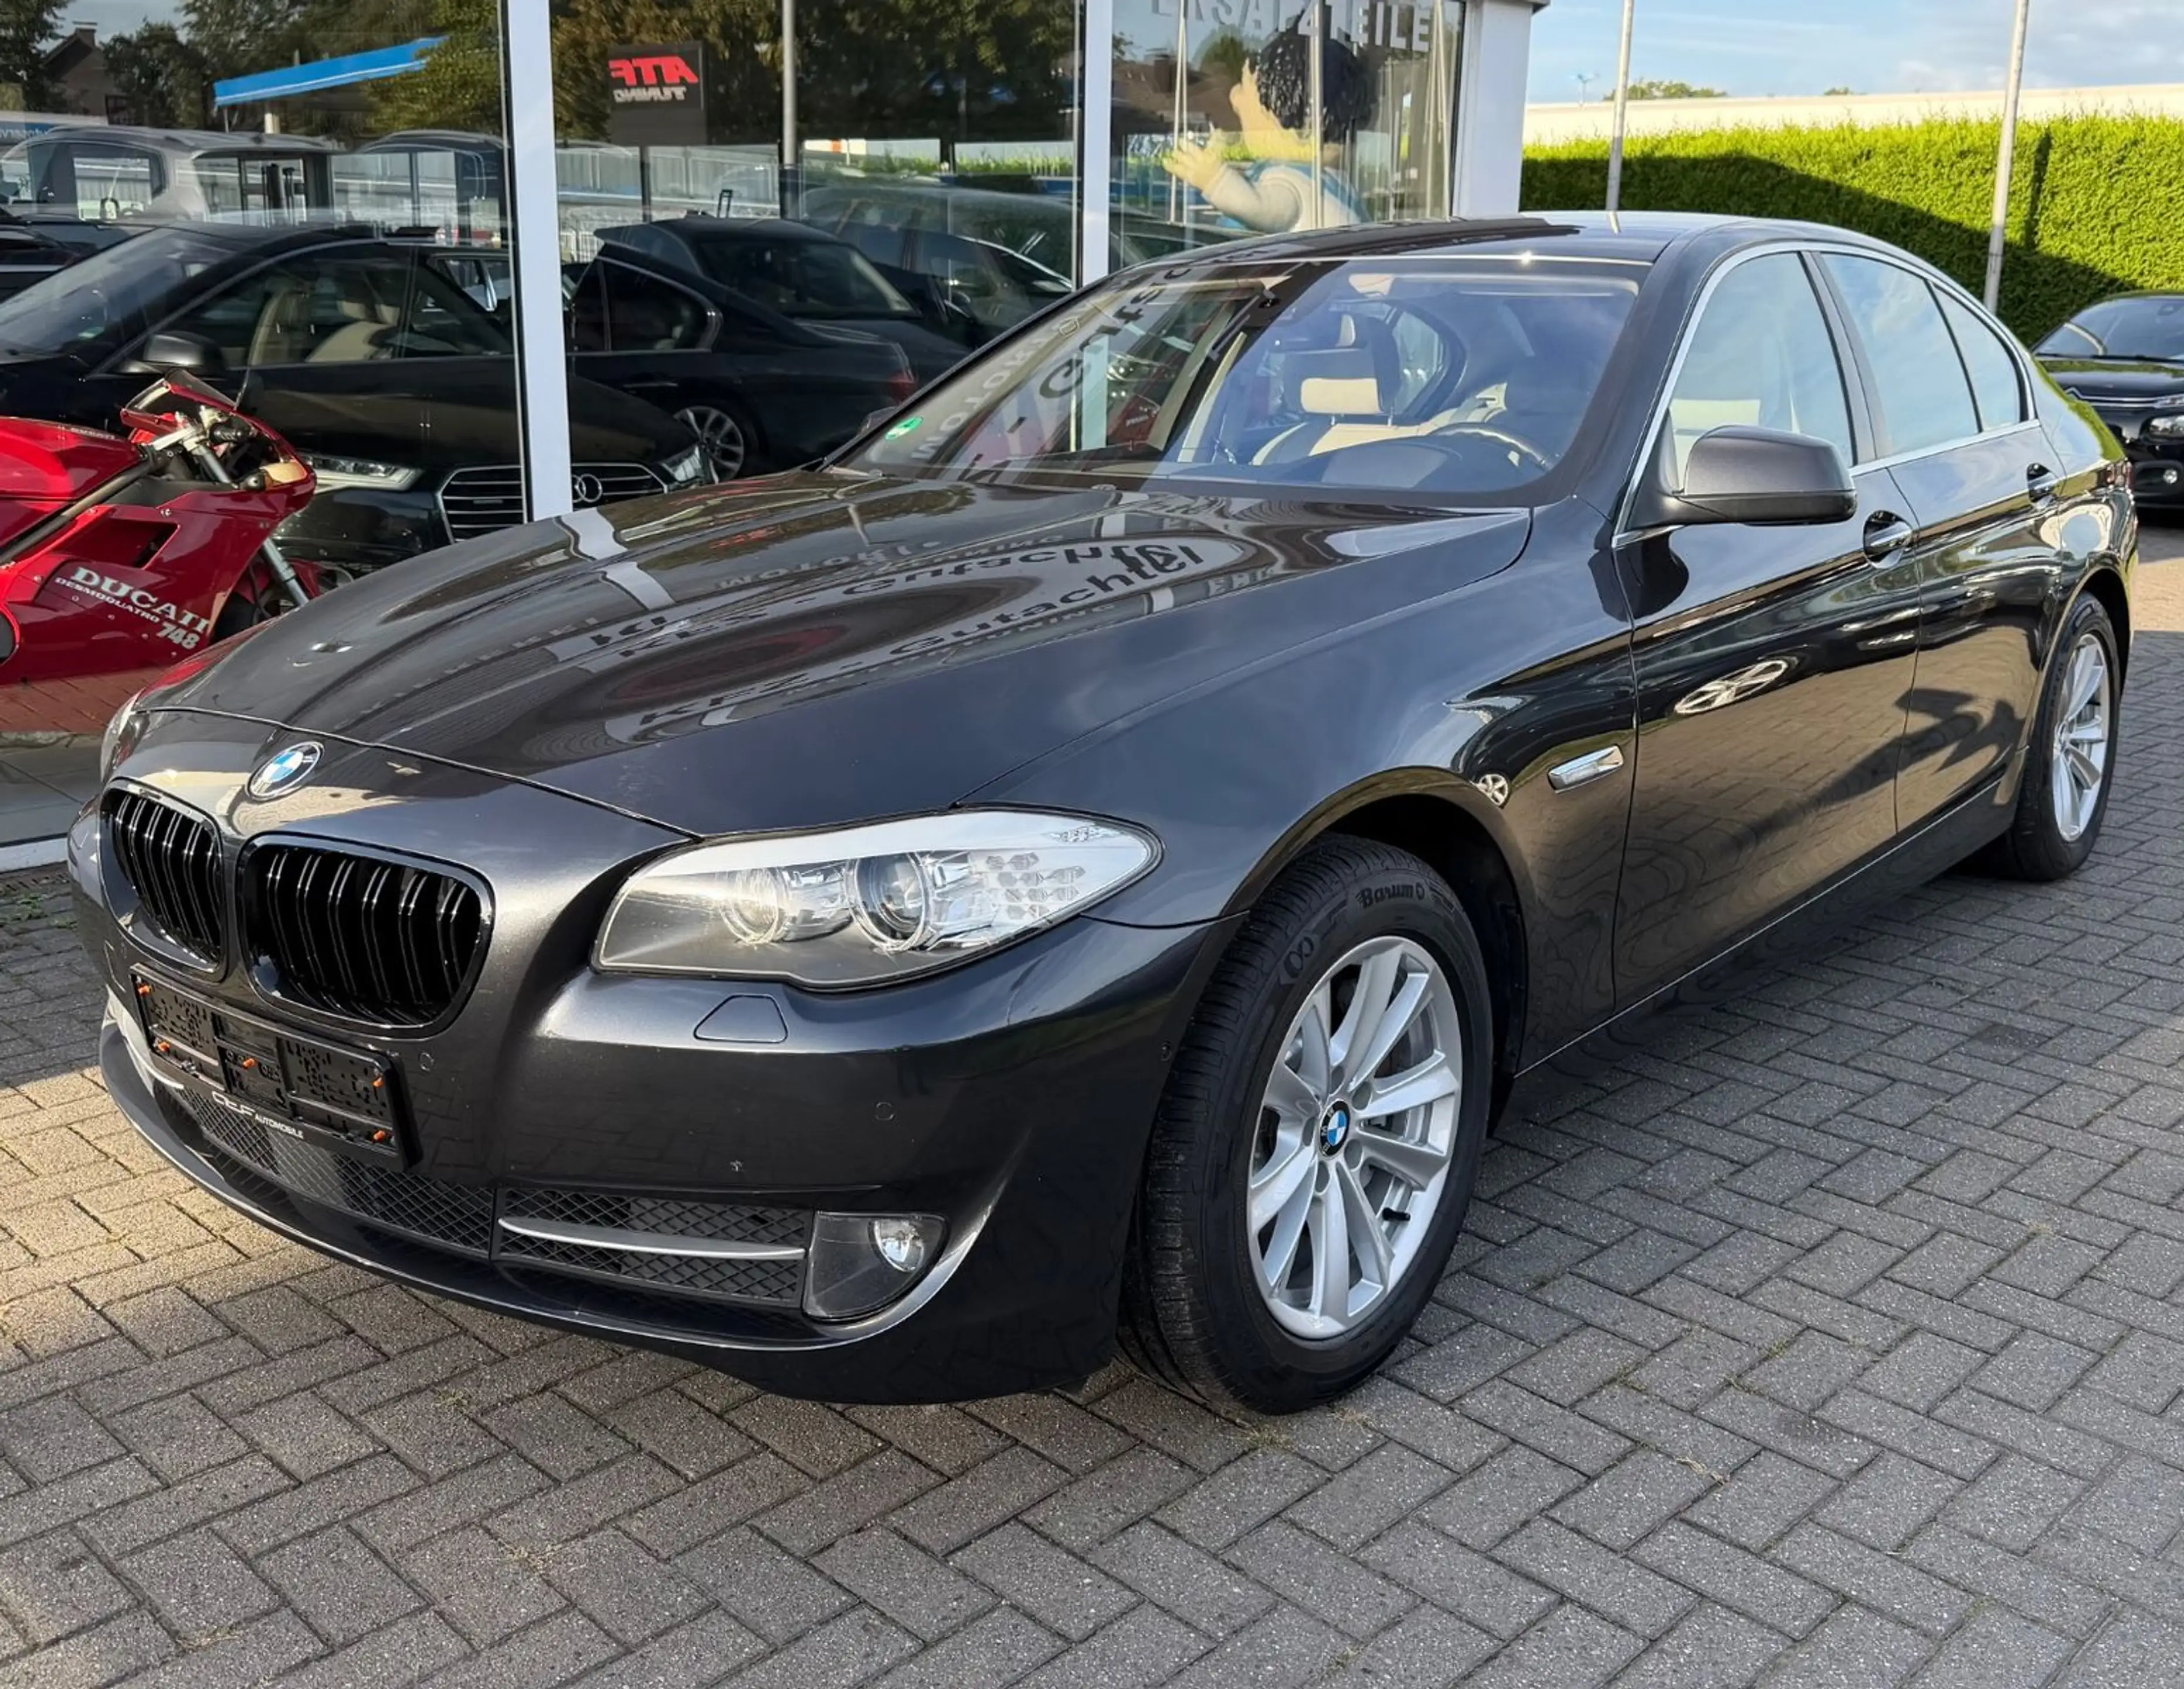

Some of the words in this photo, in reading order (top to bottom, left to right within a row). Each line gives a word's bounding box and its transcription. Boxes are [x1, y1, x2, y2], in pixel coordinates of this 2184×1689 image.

[71, 567, 209, 633] DUCATI
[156, 622, 200, 649] 748
[255, 1113, 304, 1139] AUTOMOBILE
